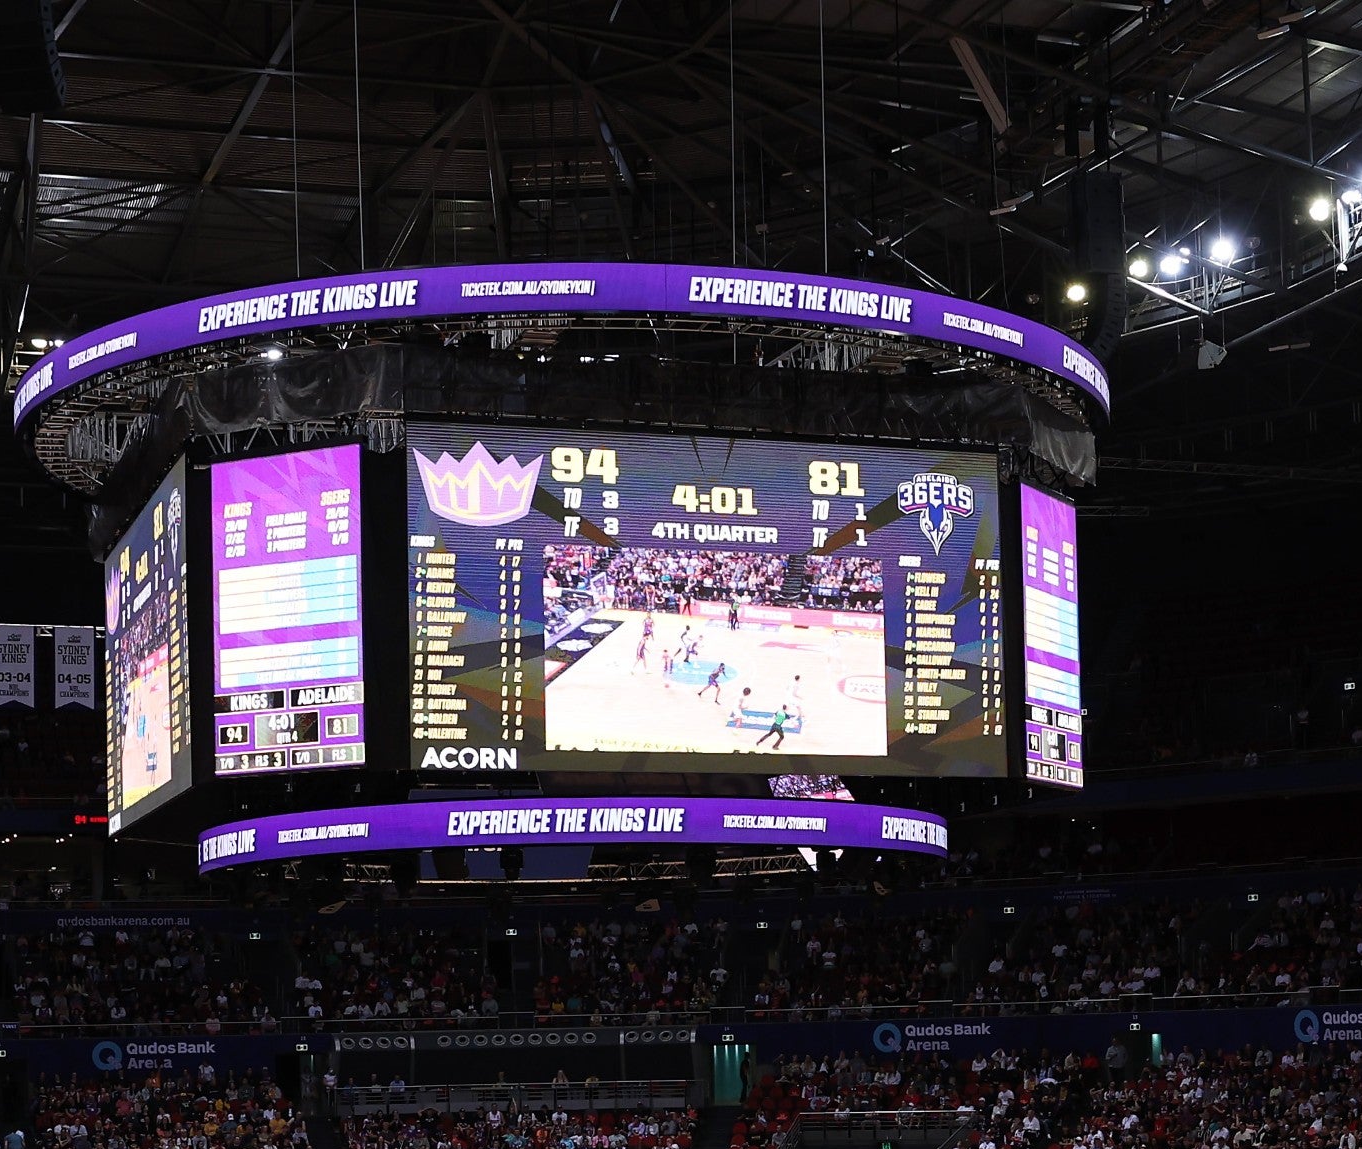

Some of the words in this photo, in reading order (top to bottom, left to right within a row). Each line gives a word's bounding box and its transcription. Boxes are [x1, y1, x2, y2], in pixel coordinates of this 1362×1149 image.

[198, 293, 288, 333] EXPERIENCE
[290, 289, 321, 317] THE
[322, 283, 377, 314] KINGS
[379, 279, 418, 308] LIVE
[689, 276, 795, 308] EXPERIENCE
[797, 284, 828, 311] THE
[829, 288, 879, 318] KINGS
[880, 295, 912, 323] LIVE
[551, 446, 620, 485] 94
[808, 460, 865, 497] 81
[915, 474, 956, 484] ADELAIDE
[563, 487, 583, 509] TO
[602, 490, 619, 509] 3
[671, 484, 759, 516] 4:01
[900, 482, 972, 511] 36ERS
[224, 502, 253, 518] KINGS
[812, 499, 830, 521] TO
[855, 502, 867, 521] 1
[153, 501, 163, 541] 81
[563, 515, 581, 537] TF
[603, 517, 619, 535] 3
[651, 521, 689, 540] 4TH
[693, 522, 779, 544] QUARTER
[812, 527, 829, 548] TF
[855, 528, 868, 546] 1
[1, 653, 27, 664] KINGS
[57, 645, 91, 655] SYDNEY
[62, 655, 87, 665] KINGS
[57, 674, 91, 684] 04-05
[0, 689, 30, 697] CHAMPIONS
[297, 686, 355, 705] ADELAIDE
[230, 694, 269, 711] KINGS
[268, 713, 295, 730] 4:01
[332, 718, 348, 734] 81
[226, 726, 243, 742] 94
[291, 731, 298, 742] 4
[241, 755, 249, 769] 3
[254, 755, 269, 766] FLS
[273, 752, 282, 766] 3
[295, 752, 310, 764] T/O
[317, 748, 323, 763] 1
[420, 746, 518, 770] ACORN
[448, 809, 550, 836] EXPERIENCE
[554, 807, 588, 833] THE
[589, 807, 645, 833] KINGS
[647, 807, 685, 833] LIVE
[881, 815, 926, 842] EXPERIENCE
[237, 828, 256, 853] LIVE
[904, 1023, 953, 1036] Qudos
[954, 1022, 991, 1035] Bank
[1322, 1027, 1362, 1041] Arena
[127, 1042, 176, 1055] Qudos
[177, 1040, 216, 1054] Bank
[905, 1039, 950, 1051] Arena
